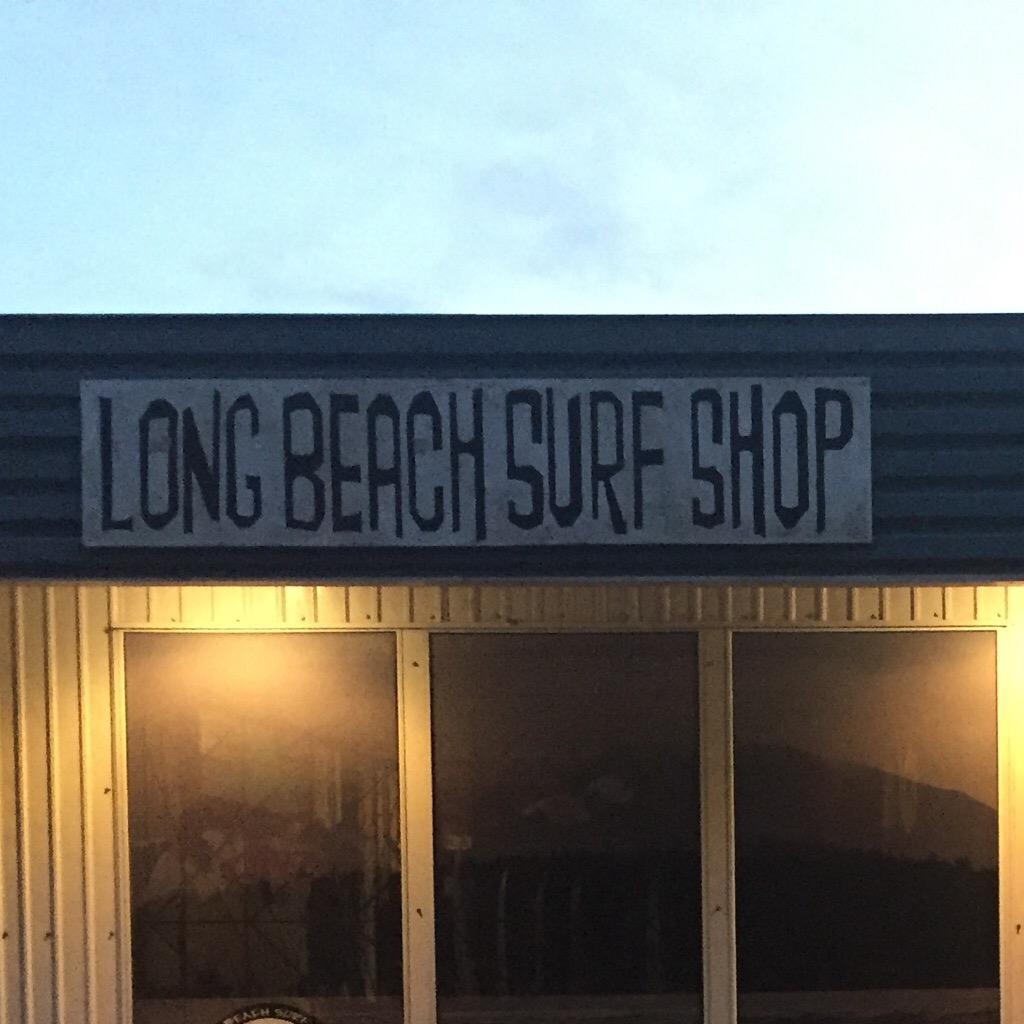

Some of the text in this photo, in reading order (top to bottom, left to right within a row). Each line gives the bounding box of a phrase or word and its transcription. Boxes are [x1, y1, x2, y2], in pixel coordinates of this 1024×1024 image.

[100, 384, 854, 541] LONG BEACH SURF SHOP
